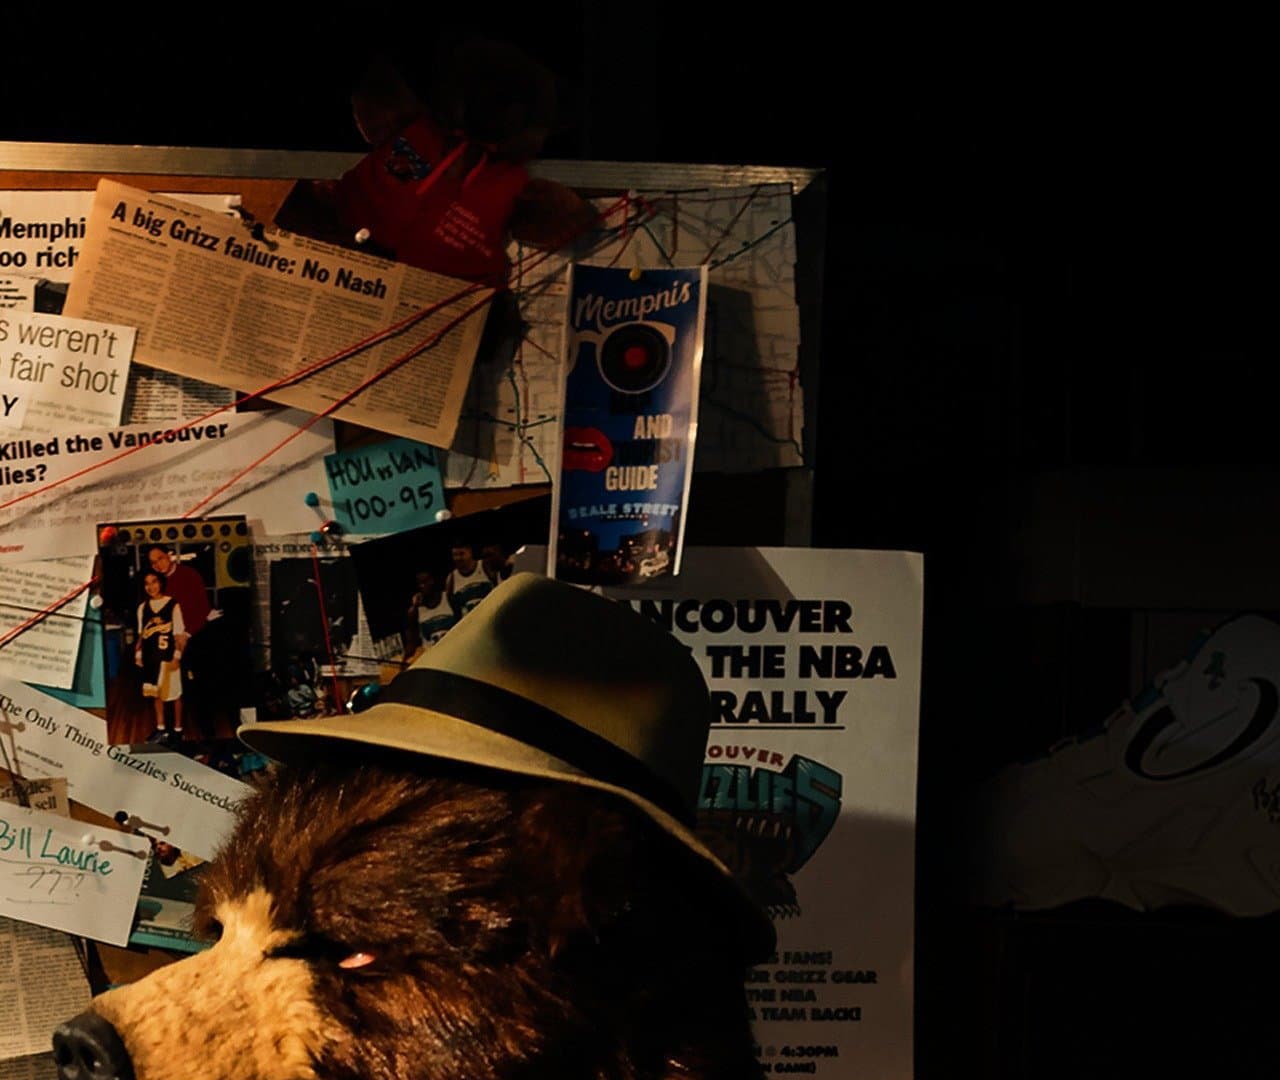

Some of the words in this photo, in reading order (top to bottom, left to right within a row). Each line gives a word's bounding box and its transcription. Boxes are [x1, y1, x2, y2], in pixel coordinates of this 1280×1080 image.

[111, 201, 127, 222] A
[130, 205, 166, 240] big
[169, 217, 221, 253] Grizz
[224, 234, 297, 276] failure:
[302, 257, 330, 285] No
[335, 271, 388, 300] Nash
[574, 279, 692, 331] Memphis
[17, 322, 119, 359] weren't
[9, 350, 54, 384] fair
[60, 361, 120, 396] shot
[66, 430, 102, 454] the
[108, 422, 229, 449] Vancouver
[632, 414, 673, 440] AND
[327, 456, 375, 490] HOU
[394, 447, 437, 476] VAN
[605, 464, 658, 491] GUIDE
[622, 502, 679, 517] STREET
[158, 636, 169, 650] 5
[706, 645, 786, 679] THE
[798, 645, 897, 679] NBA
[710, 690, 848, 724] RALLY
[25, 708, 61, 736] Only
[64, 723, 104, 757] Thing
[107, 744, 169, 783] Grizzlies
[707, 745, 784, 767] OUVER
[33, 795, 57, 811] sell
[40, 828, 114, 877] Laurie
[783, 951, 833, 965] FANS!
[774, 970, 827, 984] GRIZZ
[831, 970, 877, 984] GEAR
[746, 989, 776, 1002] THE
[780, 989, 817, 1002] NBA
[760, 1007, 806, 1020] TEAM
[810, 1007, 862, 1021] BACK!
[780, 1046, 839, 1057] 4:30PM
[774, 1062, 817, 1074] GAME)
